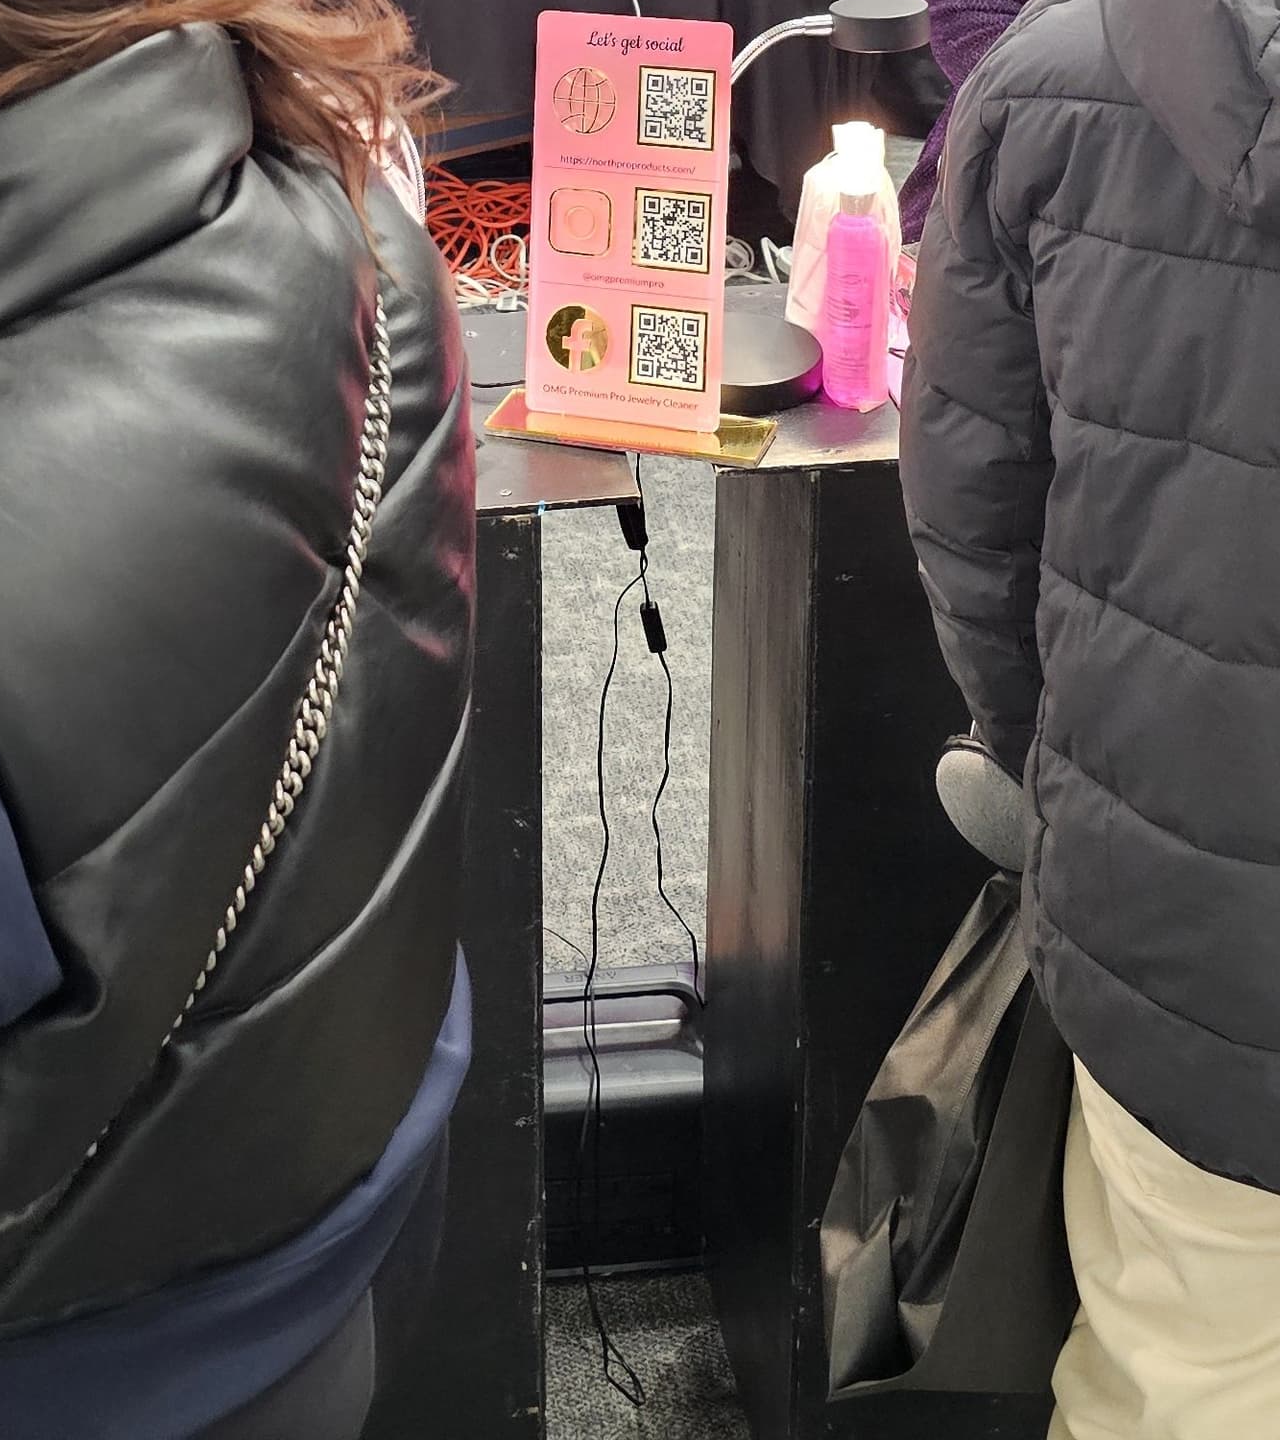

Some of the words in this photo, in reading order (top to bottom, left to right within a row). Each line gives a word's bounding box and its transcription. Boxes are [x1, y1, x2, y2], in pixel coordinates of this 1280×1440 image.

[586, 31, 617, 48] Let's
[620, 35, 642, 56] get
[645, 37, 684, 53] social
[542, 383, 568, 396] OMG
[569, 386, 609, 400] Premium
[610, 391, 626, 403] Pro
[627, 393, 661, 408] Jewelry
[662, 397, 699, 411] Cleaner
